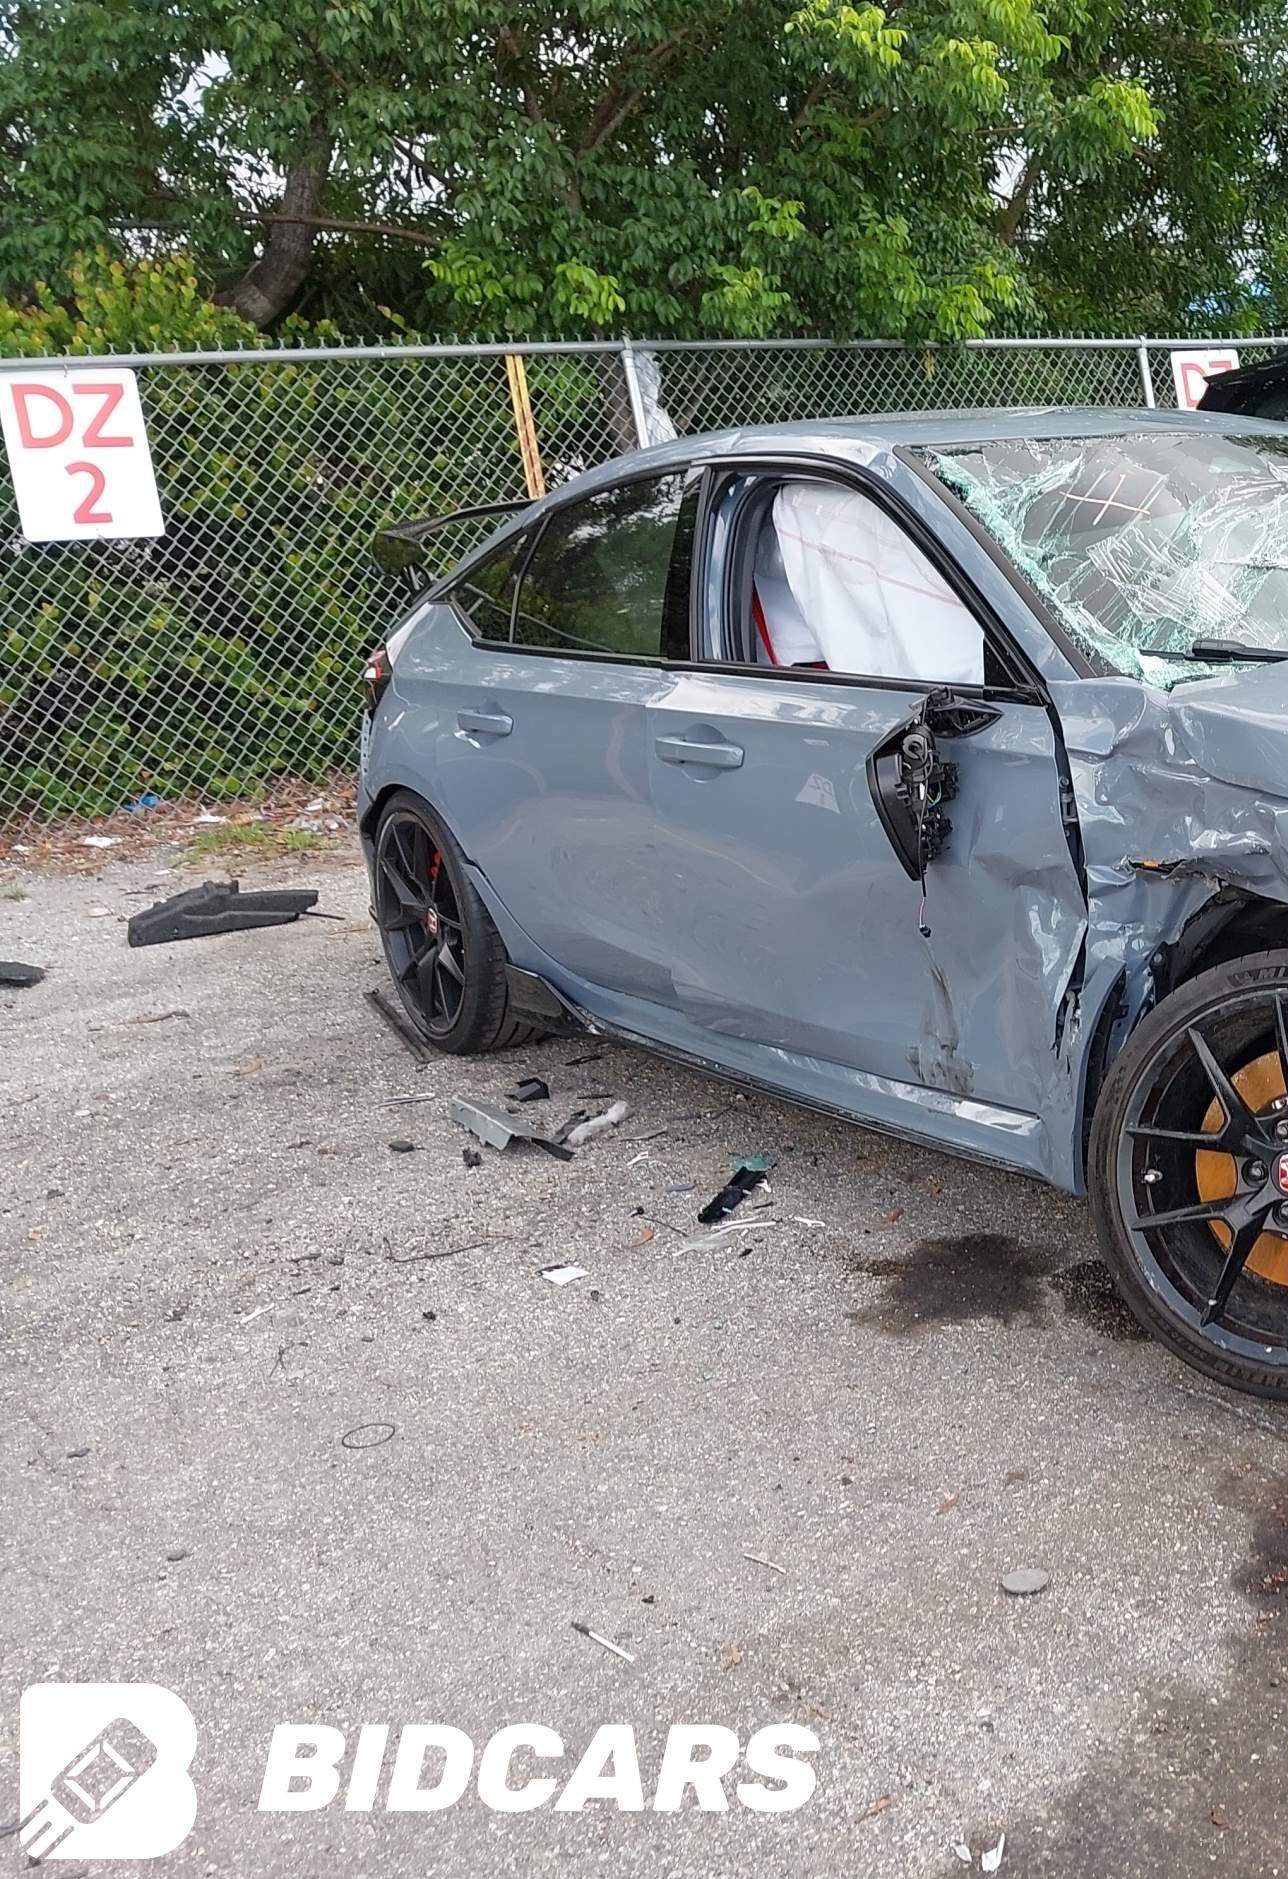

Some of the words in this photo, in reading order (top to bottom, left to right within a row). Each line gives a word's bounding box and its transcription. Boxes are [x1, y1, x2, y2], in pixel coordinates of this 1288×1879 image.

[11, 383, 134, 449] DZ
[1180, 360, 1232, 408] D
[64, 461, 113, 525] 2
